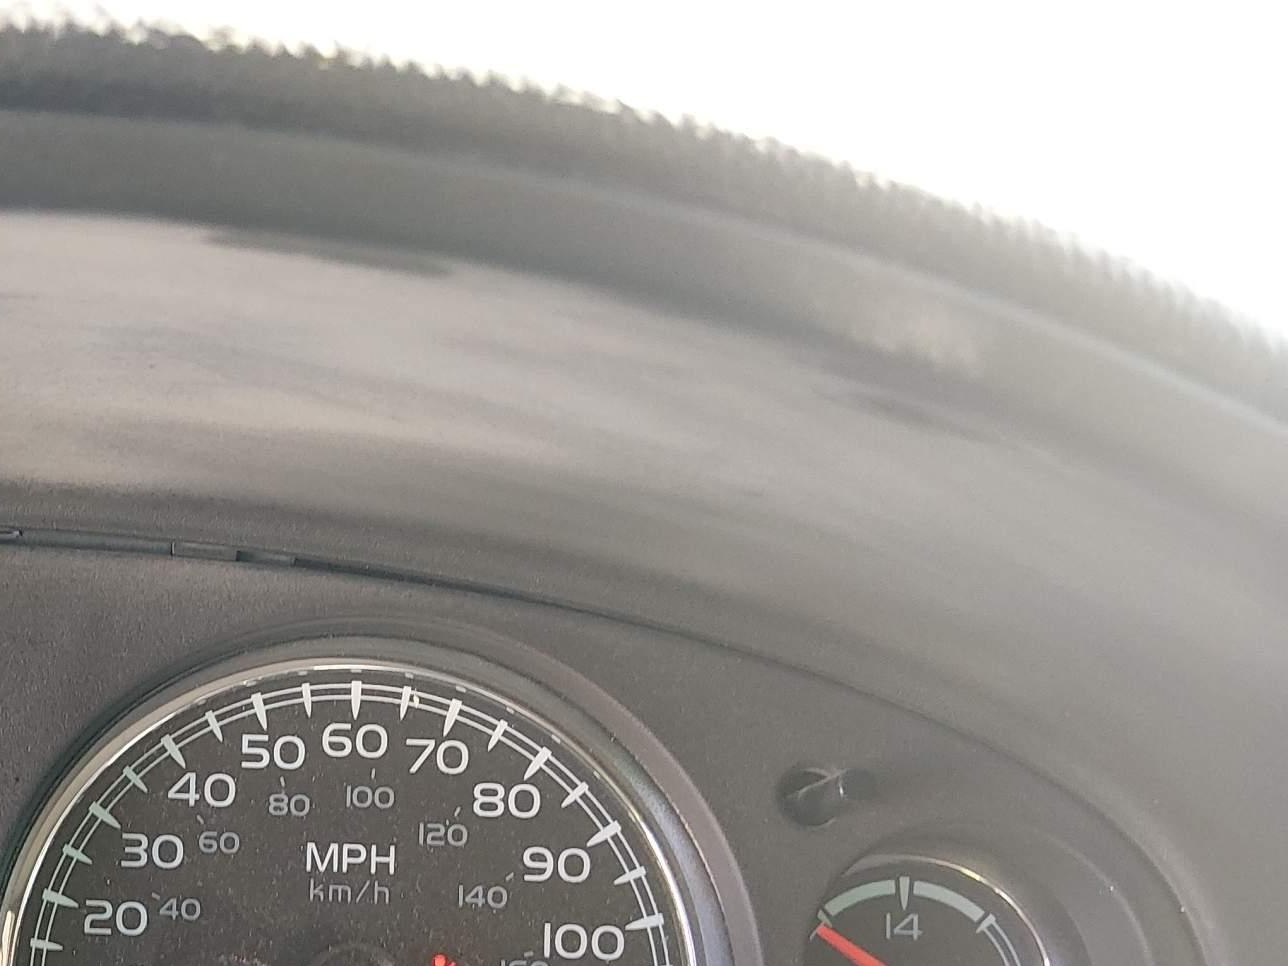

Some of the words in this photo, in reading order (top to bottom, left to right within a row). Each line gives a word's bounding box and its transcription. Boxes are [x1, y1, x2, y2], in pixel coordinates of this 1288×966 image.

[241, 734, 306, 770] 50
[322, 722, 388, 758] 60
[405, 738, 469, 775] 70
[167, 772, 236, 808] 40
[268, 791, 310, 819] 80
[346, 785, 395, 809] 100
[473, 782, 541, 819] 80
[121, 833, 184, 869] 30
[198, 831, 240, 854] 60
[418, 822, 468, 848] 120
[306, 842, 395, 875] MPH
[522, 846, 591, 883] 90
[309, 878, 390, 905] km/h
[458, 884, 508, 909] 140
[84, 899, 148, 936] 20
[159, 897, 201, 921] 40
[543, 922, 625, 961] 100
[885, 912, 923, 941] 14
